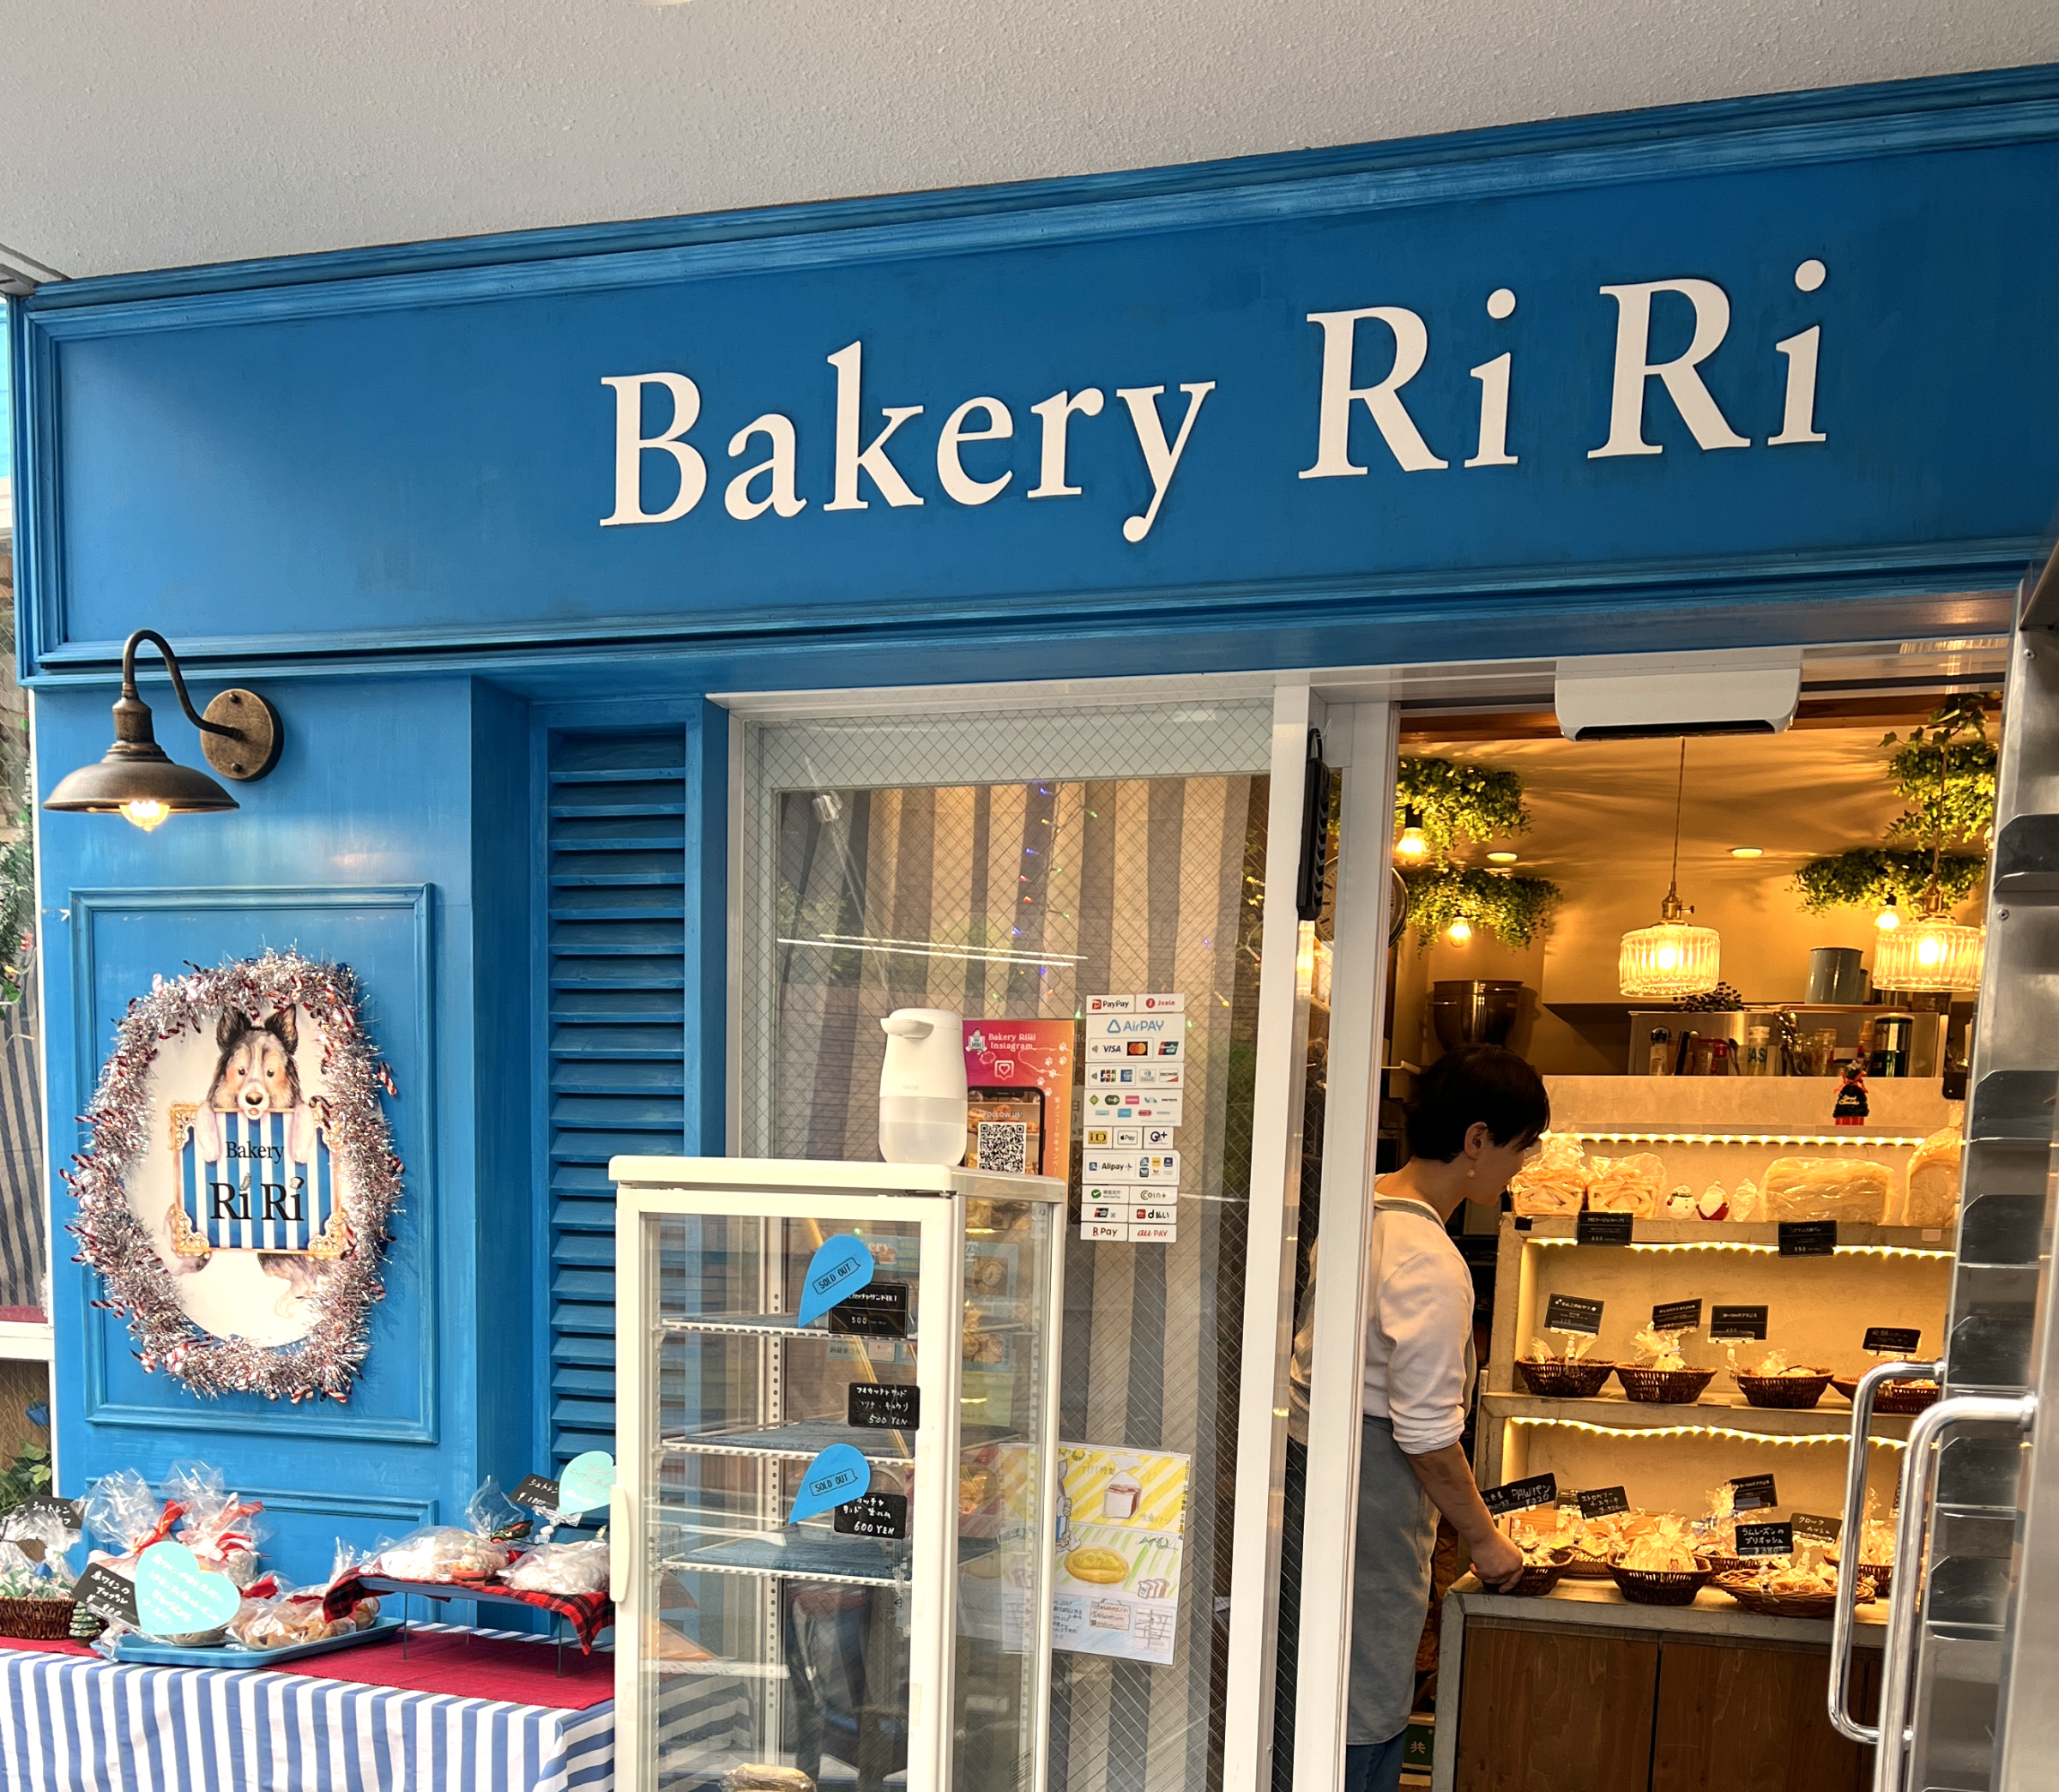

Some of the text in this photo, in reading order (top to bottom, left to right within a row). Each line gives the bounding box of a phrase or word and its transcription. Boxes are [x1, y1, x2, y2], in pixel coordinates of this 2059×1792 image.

[599, 258, 1827, 543] Bakery Ri Ri
[1102, 1000, 1129, 1009] PayPay
[988, 1033, 1017, 1042] Bakery
[990, 1041, 1033, 1052] Instagram
[225, 1140, 285, 1164] Bakery
[1100, 1228, 1118, 1237] Pay
[818, 1264, 851, 1289] SOLD OUT
[869, 1414, 909, 1425] 500 YEN
[815, 1474, 848, 1492] SOLD OUT
[854, 1520, 895, 1536] 600 YEN
[91, 1570, 131, 1595] 赤ワインの
[95, 1586, 129, 1605] アップル
[1410, 1741, 1427, 1754] 共
